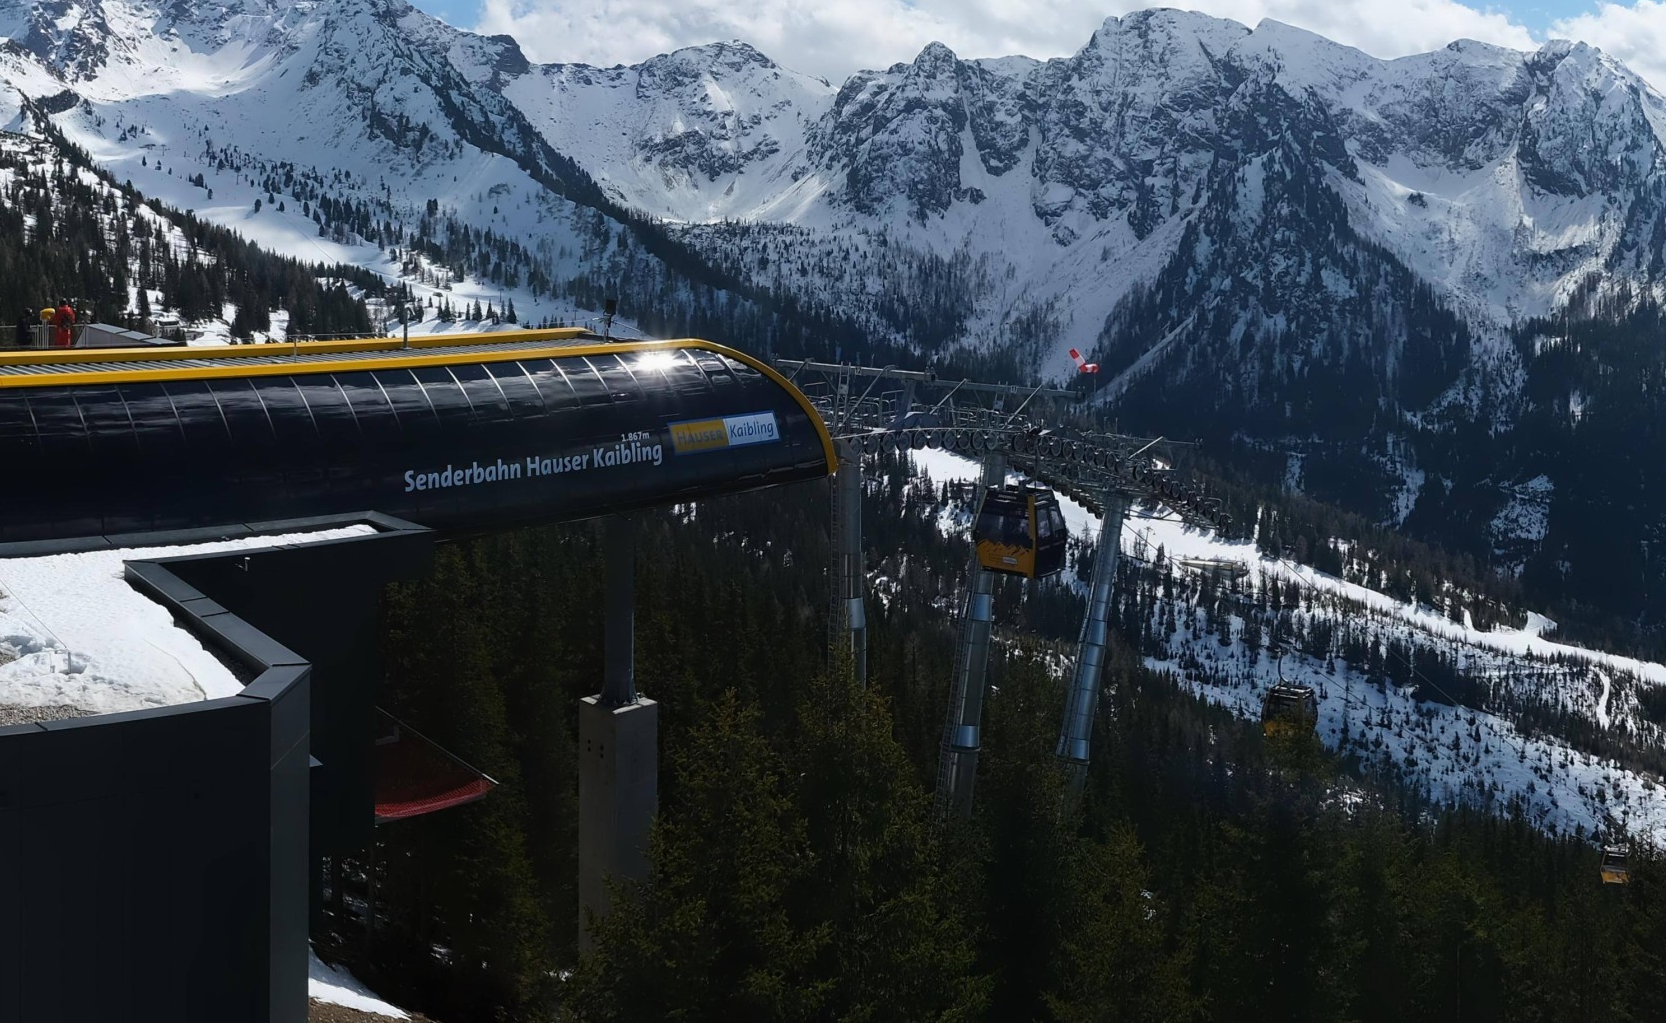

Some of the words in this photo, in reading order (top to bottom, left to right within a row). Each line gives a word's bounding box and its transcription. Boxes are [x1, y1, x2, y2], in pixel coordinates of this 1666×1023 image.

[621, 431, 650, 443] 1.867m
[677, 430, 724, 445] HAUSER
[730, 421, 774, 439] Kaibling
[404, 459, 521, 492] Senderbahn
[526, 454, 589, 476] Hauser
[593, 442, 662, 468] Kaibling
